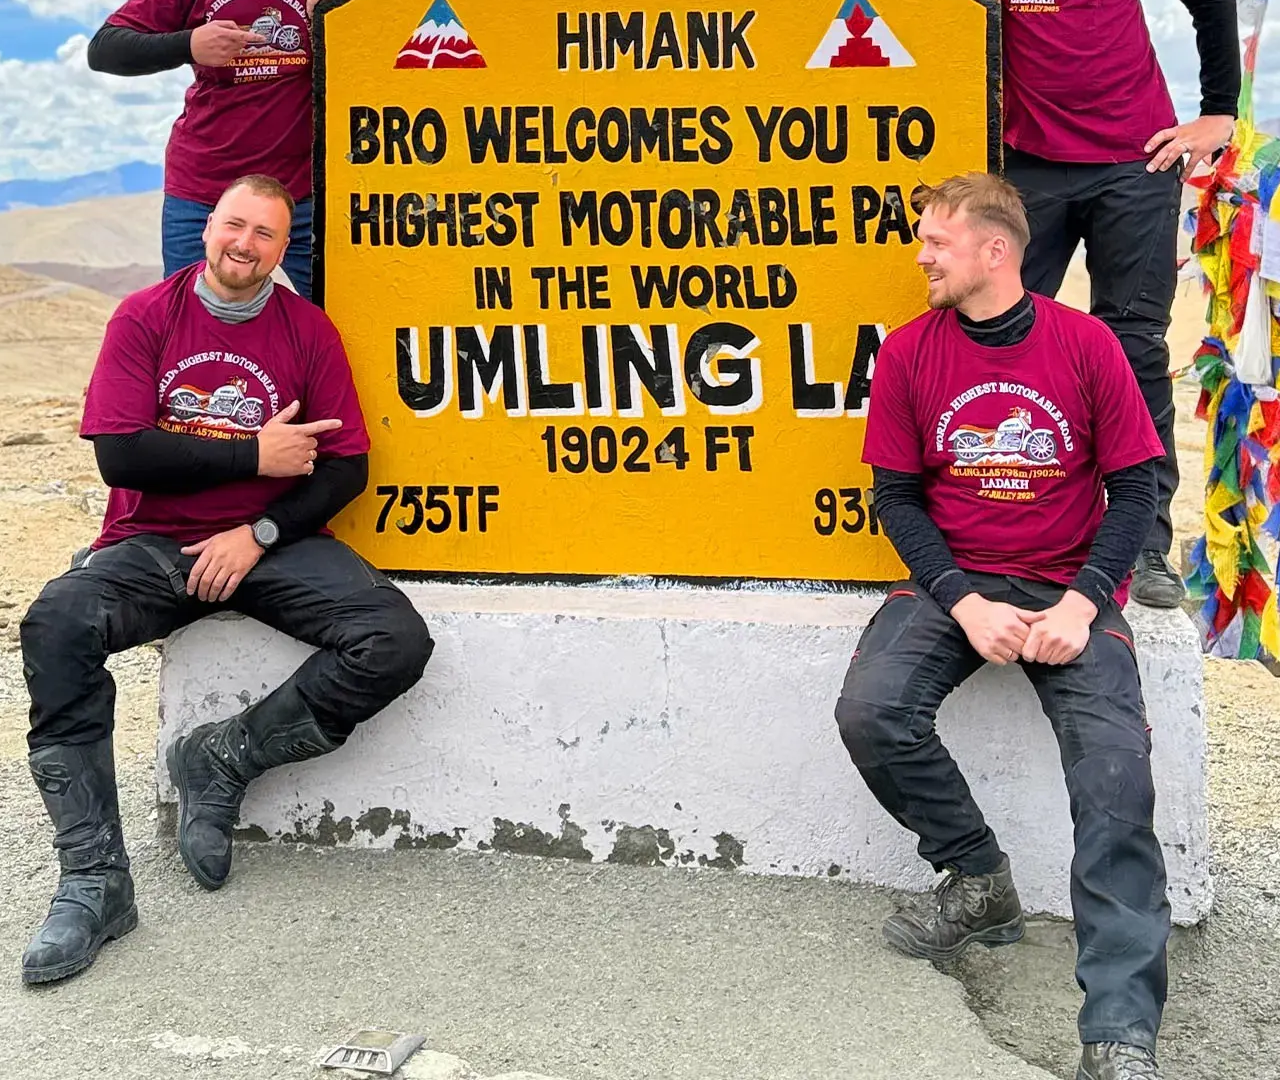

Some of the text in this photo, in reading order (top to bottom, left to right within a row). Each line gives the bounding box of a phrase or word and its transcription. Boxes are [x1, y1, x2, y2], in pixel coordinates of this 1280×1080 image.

[557, 11, 756, 70] HIMANK
[235, 65, 279, 77] LADAKH
[349, 105, 936, 165] BRO WELCOMES YOU TO
[350, 191, 540, 248] HIGHEST
[560, 185, 838, 249] MOTORABLE
[474, 264, 798, 310] IN THE WORLD
[177, 351, 222, 371] HIGHEST
[223, 352, 276, 393] MOTORABLE
[269, 392, 280, 416] ROA
[394, 322, 887, 419] UMLING LA
[949, 382, 998, 412] HIGHEST
[999, 382, 1063, 420] MOTORABLE
[1057, 419, 1074, 452] ROAD
[541, 425, 755, 474] 19024 FT
[375, 485, 500, 535] 755TF
[980, 478, 1029, 490] LADAKH
[814, 487, 880, 536] 93
